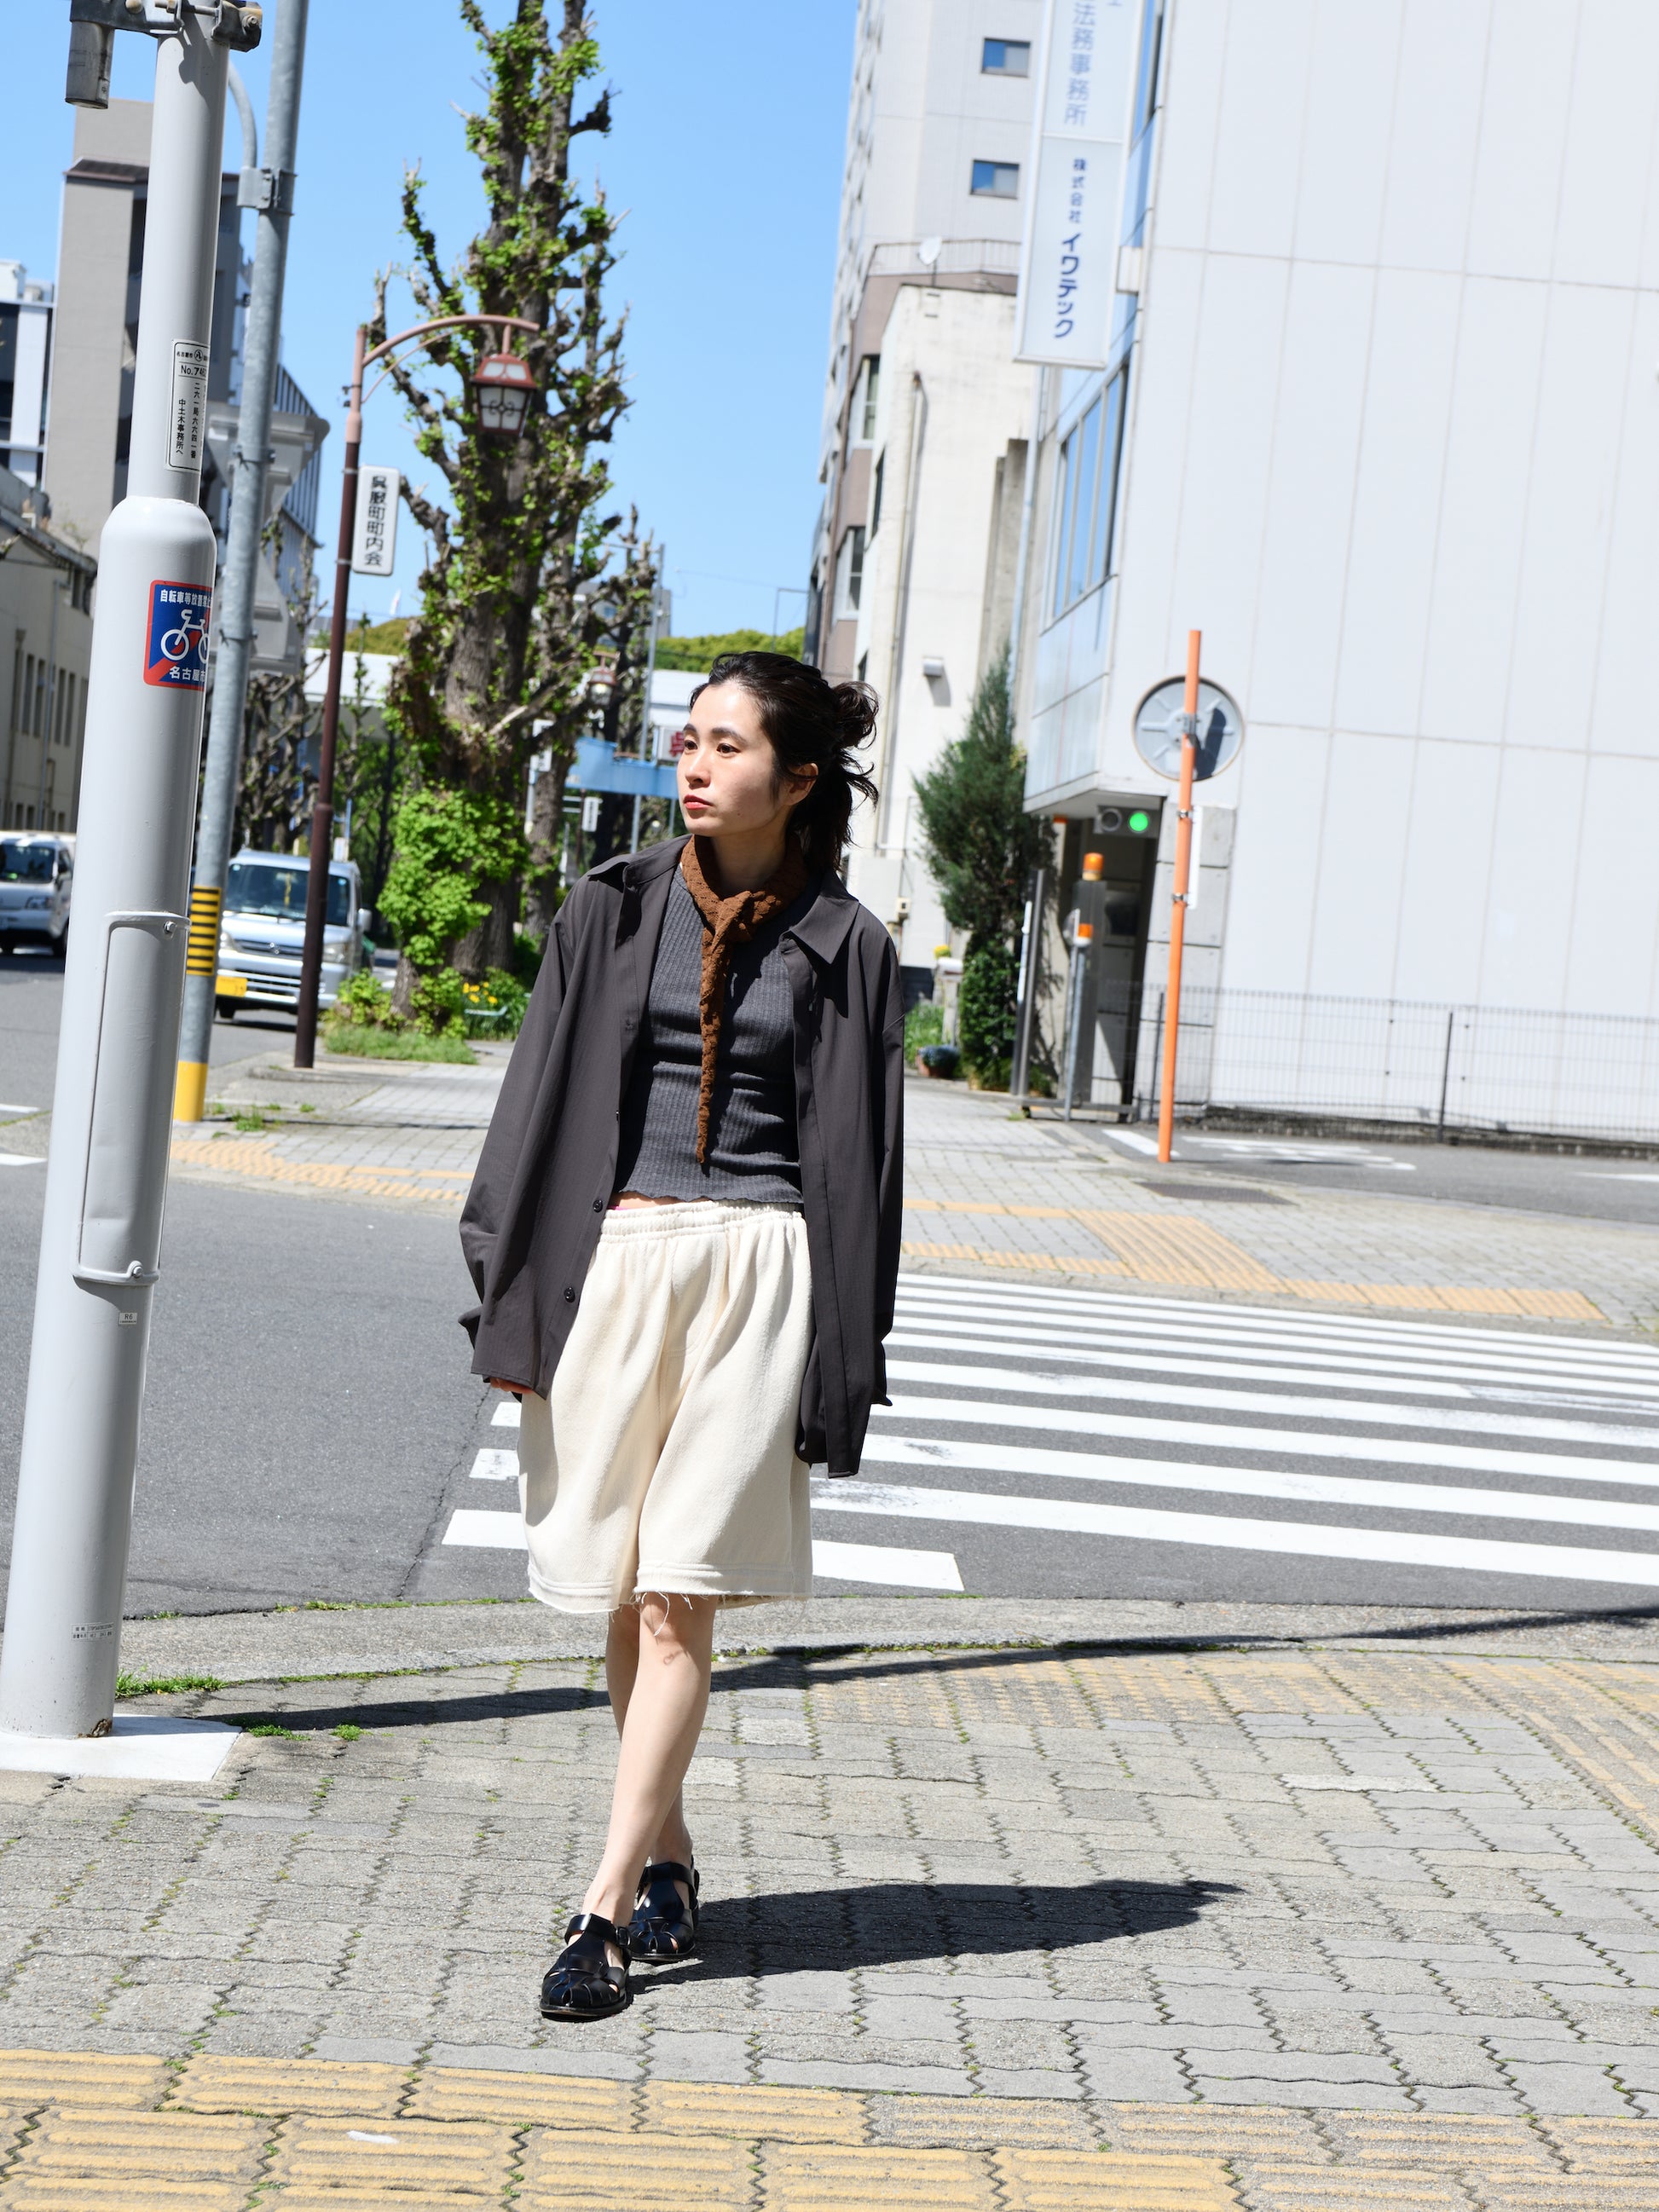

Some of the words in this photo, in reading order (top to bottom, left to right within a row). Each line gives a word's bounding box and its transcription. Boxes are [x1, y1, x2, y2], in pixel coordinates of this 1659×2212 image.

[1063, 0, 1096, 126] 法務事務所
[365, 476, 387, 567] 呉服町町内会
[160, 589, 211, 608] 自転車等放置禁止
